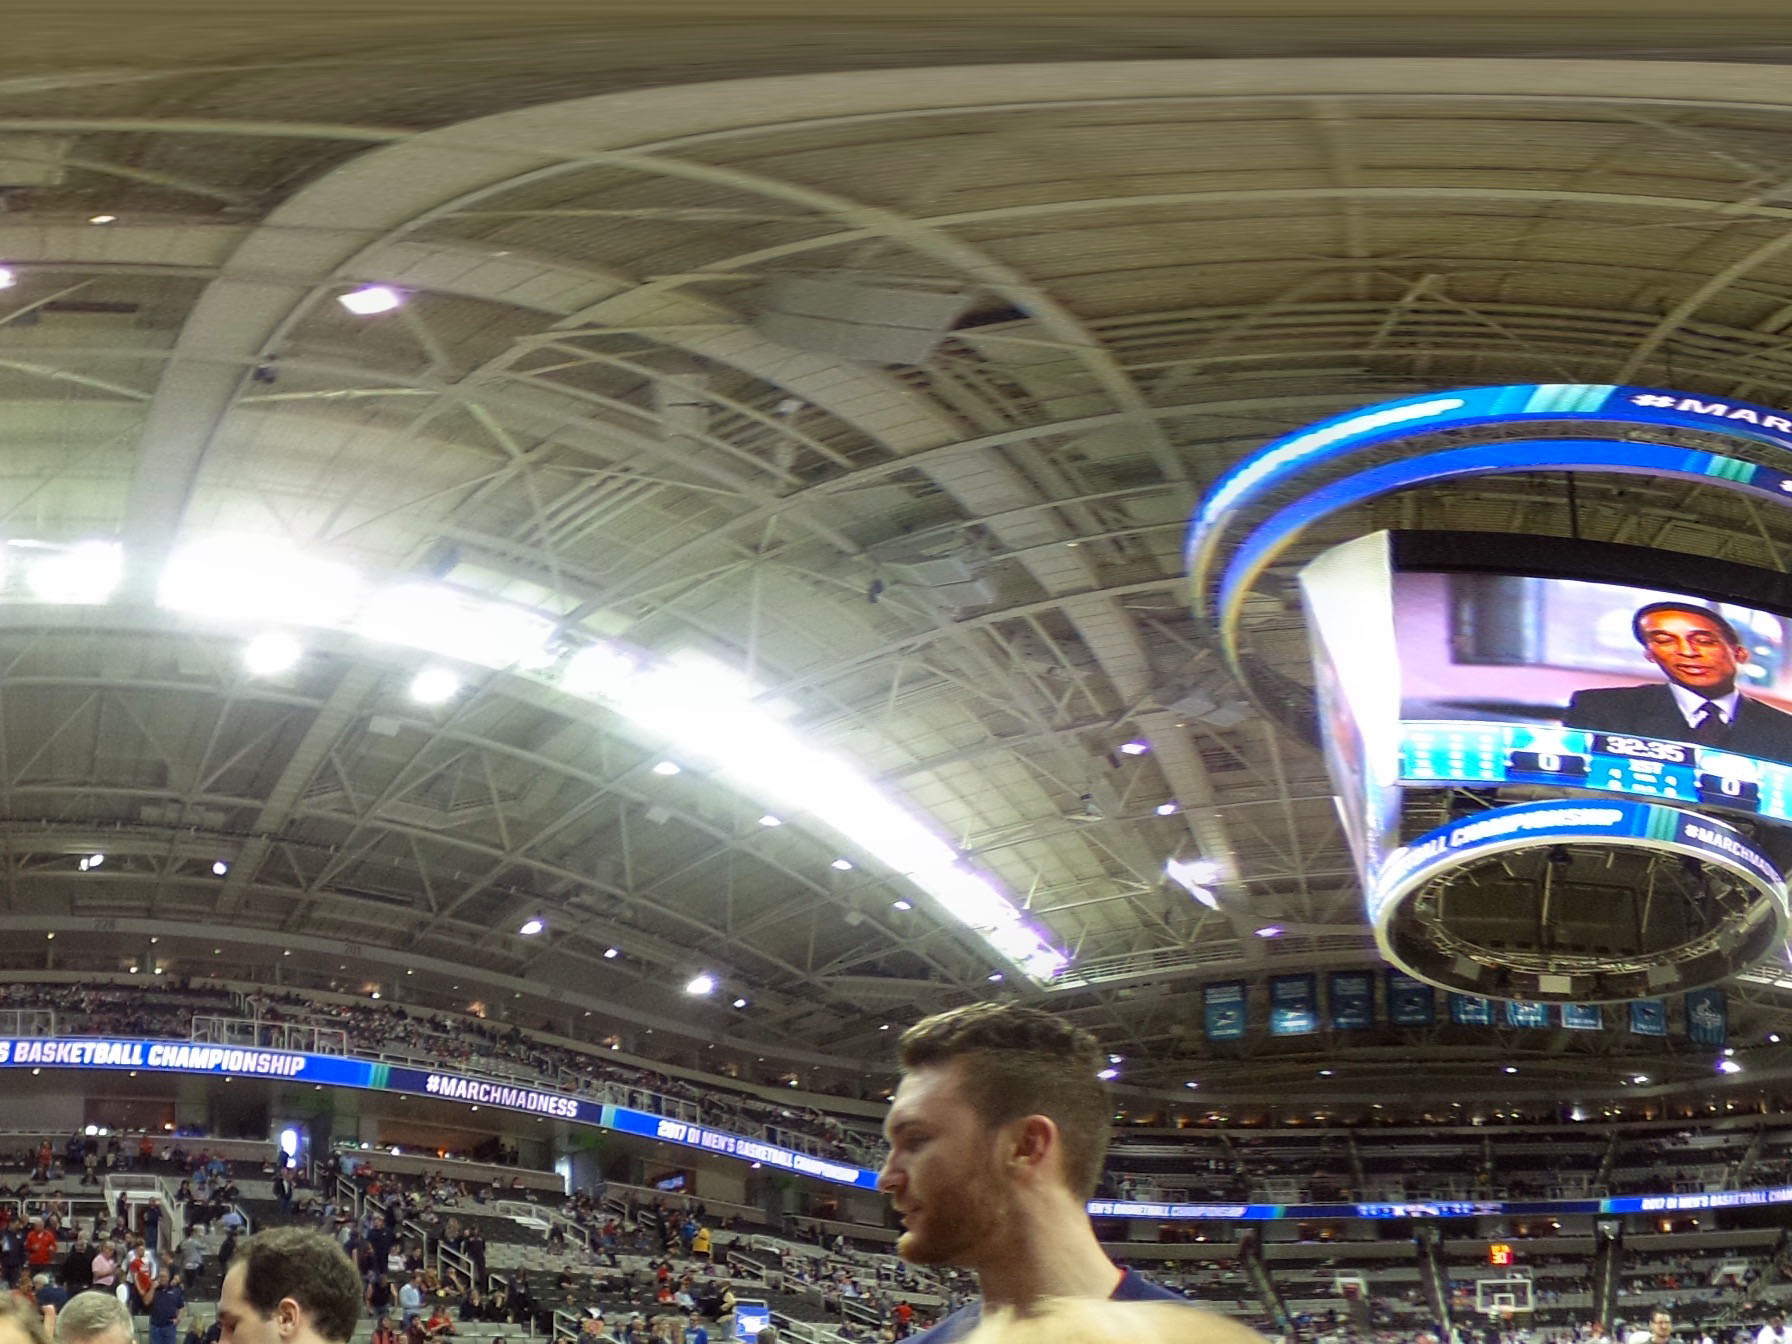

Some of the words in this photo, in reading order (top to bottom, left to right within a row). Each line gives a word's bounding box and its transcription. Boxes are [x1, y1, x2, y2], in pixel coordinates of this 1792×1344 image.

[1538, 752, 1560, 771] 0
[1720, 777, 1741, 796] 0
[13, 1041, 143, 1066] BASKETBALL
[147, 1043, 305, 1077] CHAMPIONSHIP
[425, 1074, 579, 1119] #MARCHMADNESS
[657, 1119, 688, 1142] 2017
[701, 1131, 736, 1153] MEN'S
